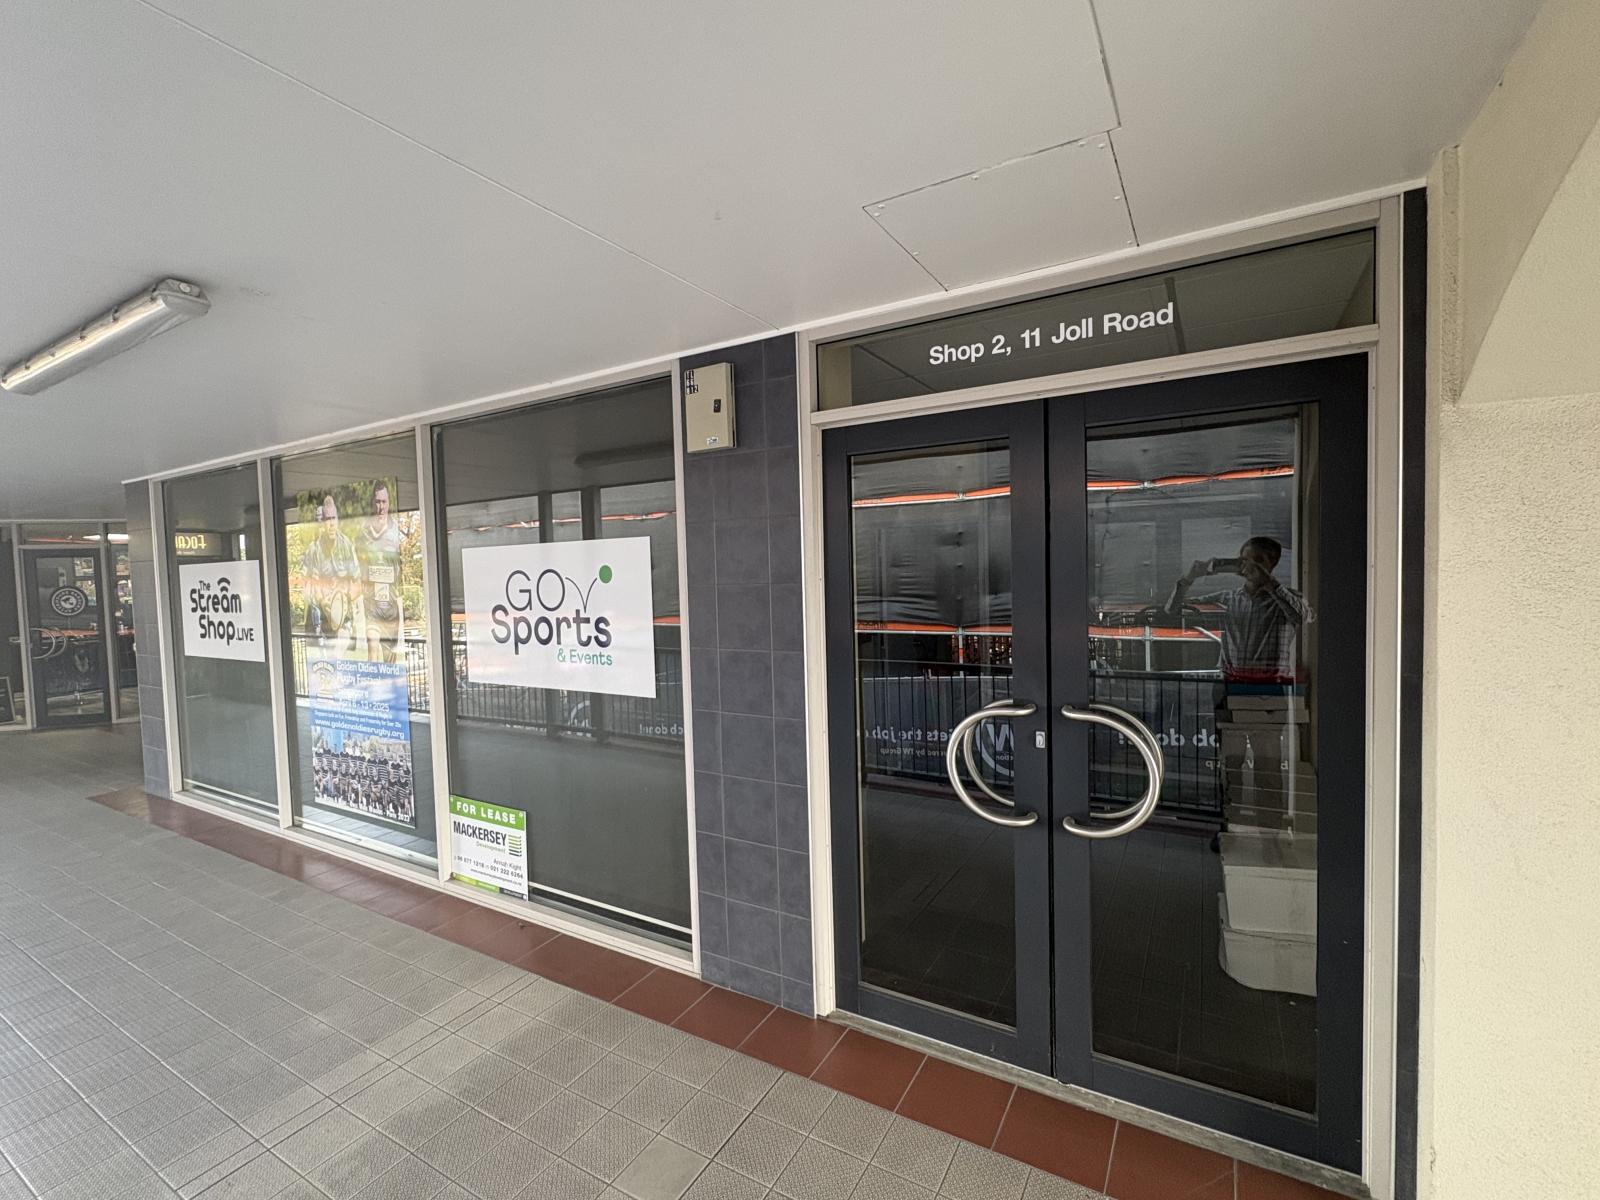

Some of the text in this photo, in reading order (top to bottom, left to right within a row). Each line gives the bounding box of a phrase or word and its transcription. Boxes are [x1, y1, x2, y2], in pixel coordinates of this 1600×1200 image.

[929, 302, 1174, 365] Shop 2, 11 Joll Road
[199, 580, 211, 591] The
[506, 568, 565, 612] GO
[190, 588, 242, 613] Stream
[491, 604, 612, 655] Sports
[336, 660, 357, 672] Golden
[379, 663, 400, 675] World
[557, 648, 613, 666] & Events
[373, 702, 390, 711] 2025
[456, 801, 516, 824] FOR LEASE
[453, 820, 507, 846] MACKERSEY
